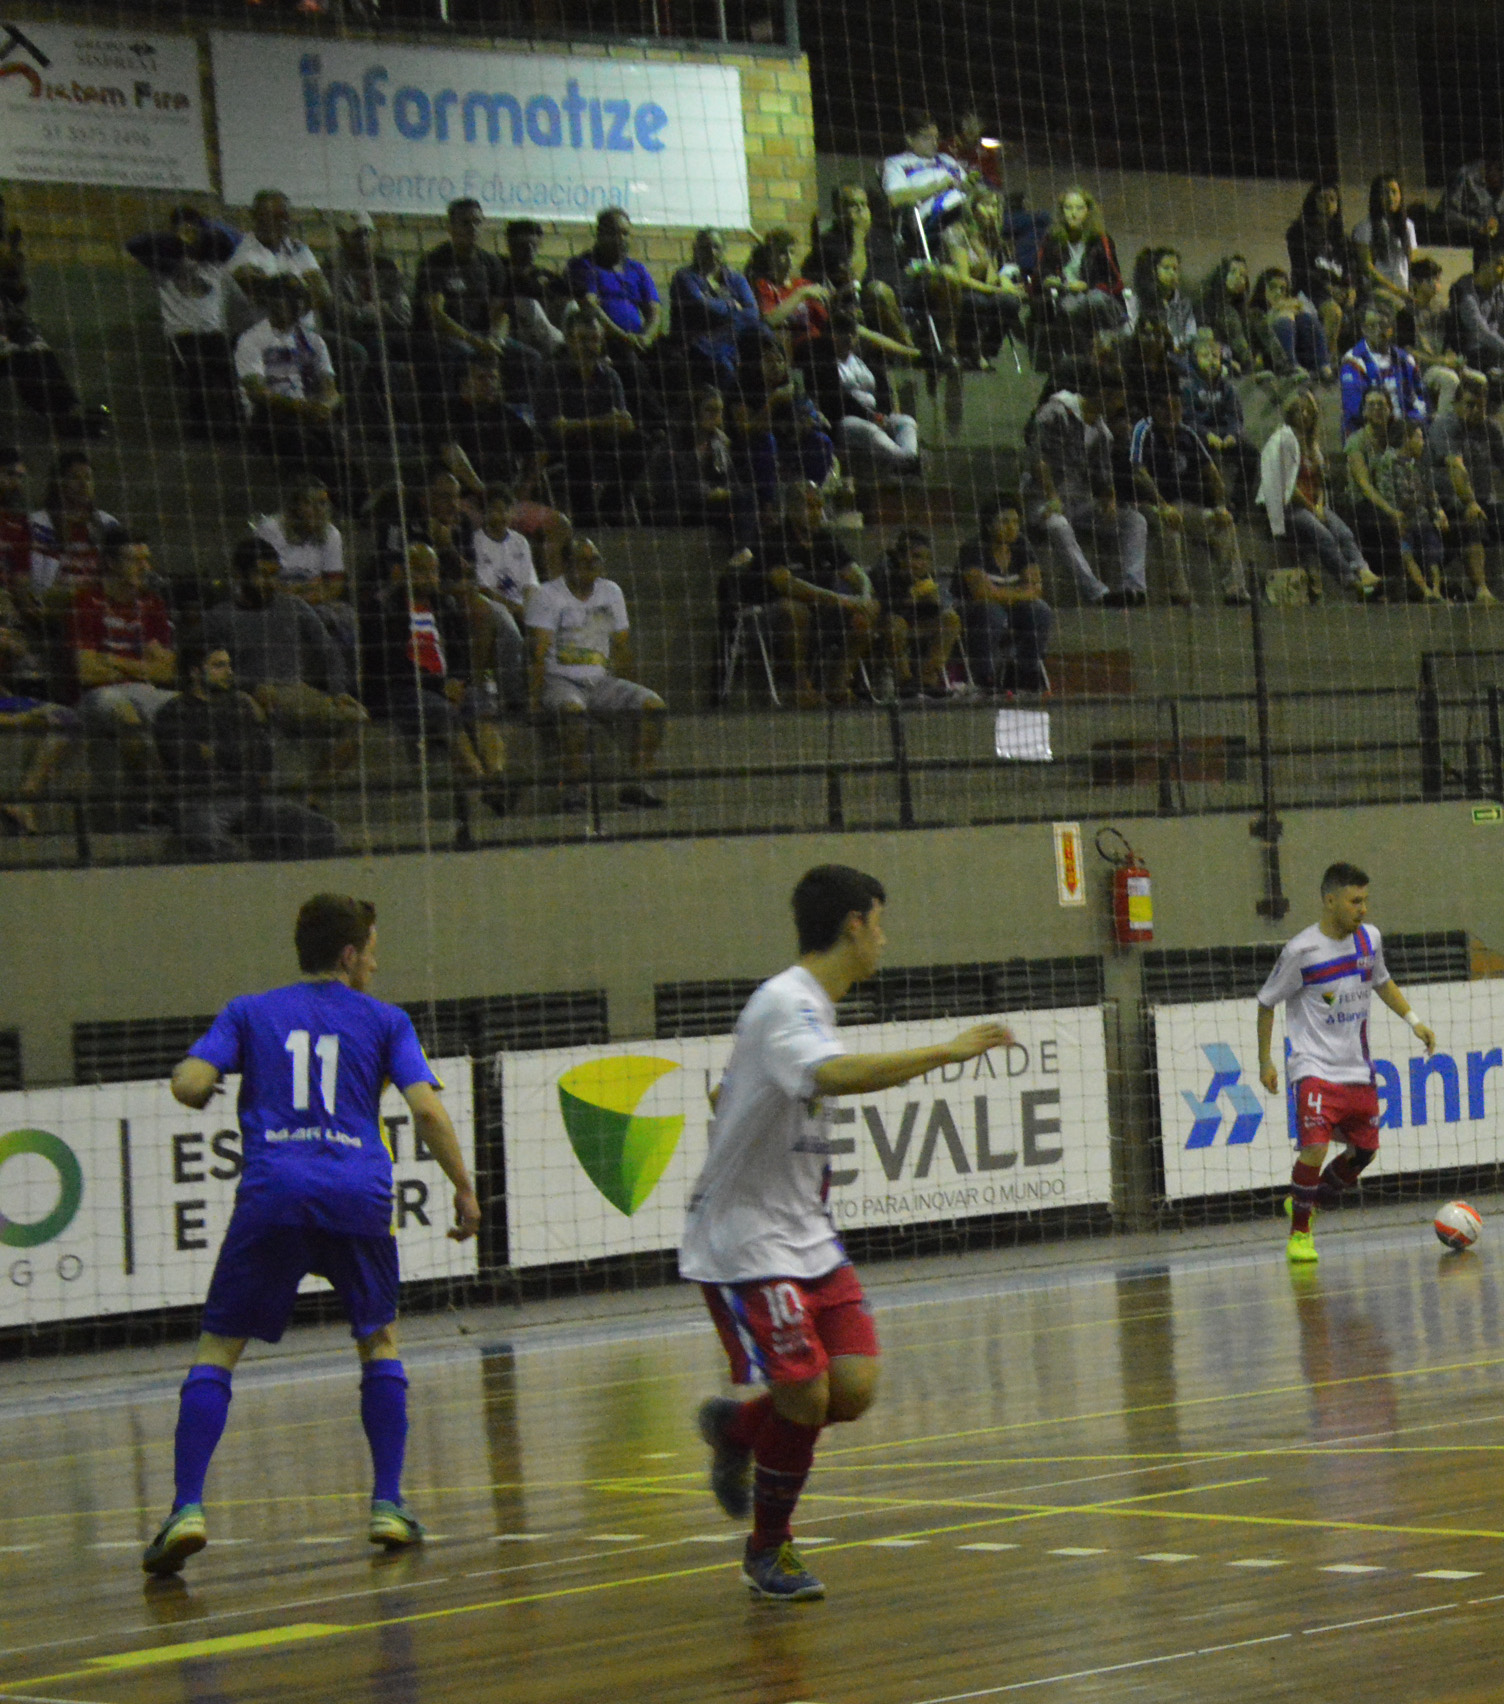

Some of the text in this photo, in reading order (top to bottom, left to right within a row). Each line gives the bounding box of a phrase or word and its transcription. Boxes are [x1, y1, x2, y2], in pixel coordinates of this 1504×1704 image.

[299, 52, 669, 153] informatize
[356, 163, 631, 208] Centro Educacional
[284, 1029, 340, 1117] 11
[1307, 1091, 1322, 1115] 4
[862, 1194, 911, 1218] PARA
[913, 1187, 979, 1211] INOVAR
[1000, 1177, 1066, 1202] MUNDO
[760, 1282, 805, 1330] 10
